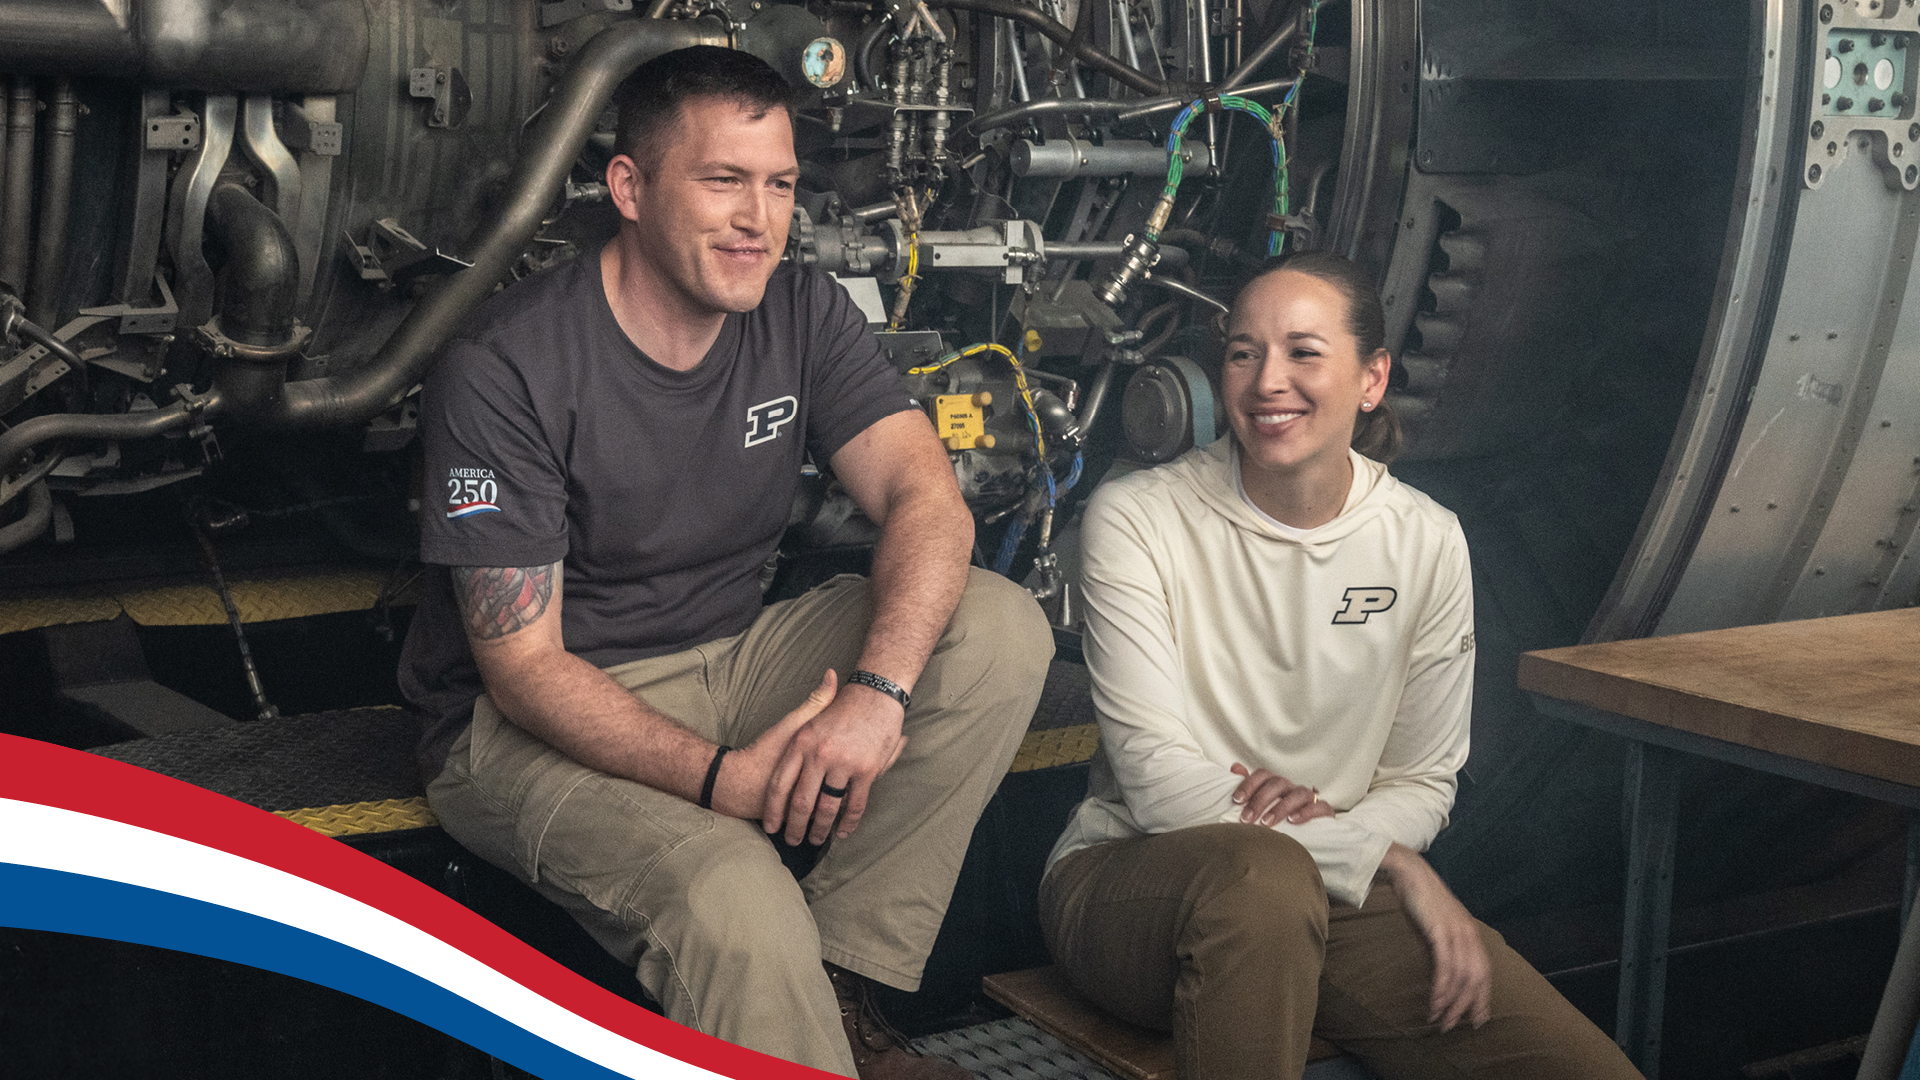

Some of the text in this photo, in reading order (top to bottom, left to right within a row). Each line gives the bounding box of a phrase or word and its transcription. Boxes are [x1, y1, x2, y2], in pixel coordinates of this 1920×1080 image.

[745, 395, 798, 448] P
[449, 468, 495, 479] AMERICA
[448, 479, 498, 504] 250
[1331, 587, 1398, 625] P
